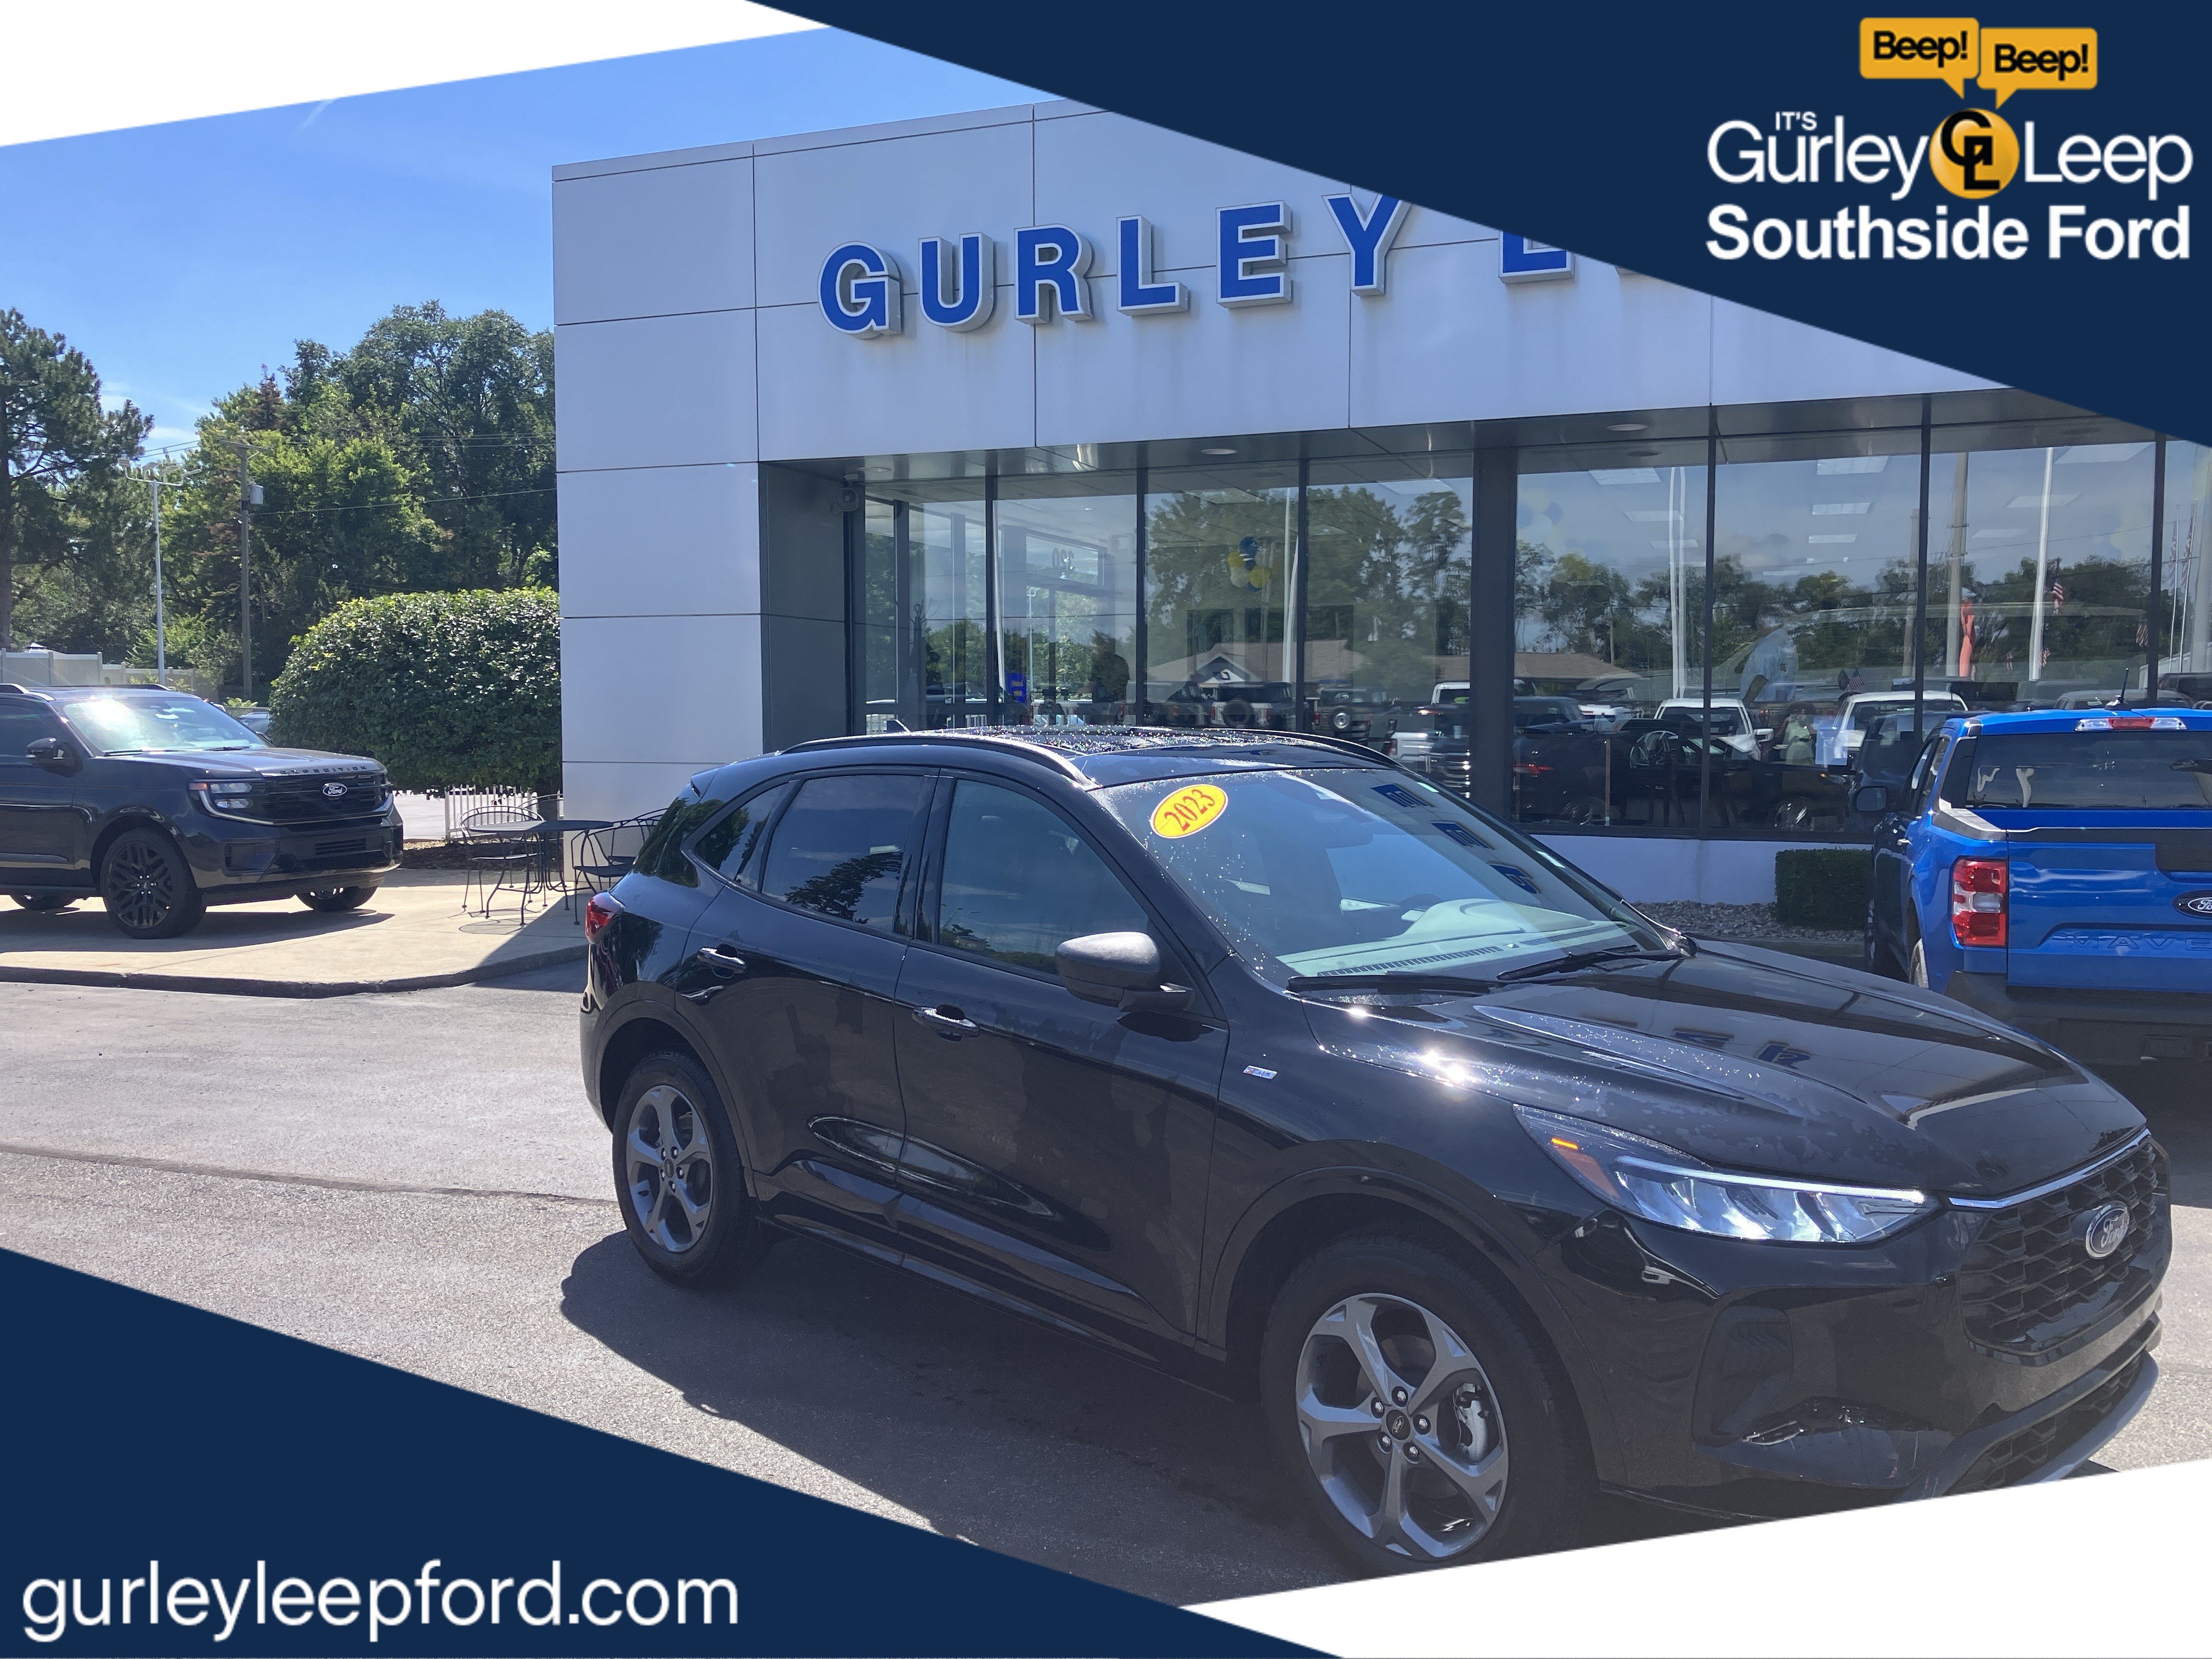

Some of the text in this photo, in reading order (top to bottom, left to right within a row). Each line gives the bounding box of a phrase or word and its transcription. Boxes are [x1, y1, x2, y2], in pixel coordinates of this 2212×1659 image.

[818, 193, 1411, 339] GURLEY
[328, 786, 343, 795] Ford
[1164, 788, 1216, 832] 2023
[2101, 1215, 2125, 1248] Ford
